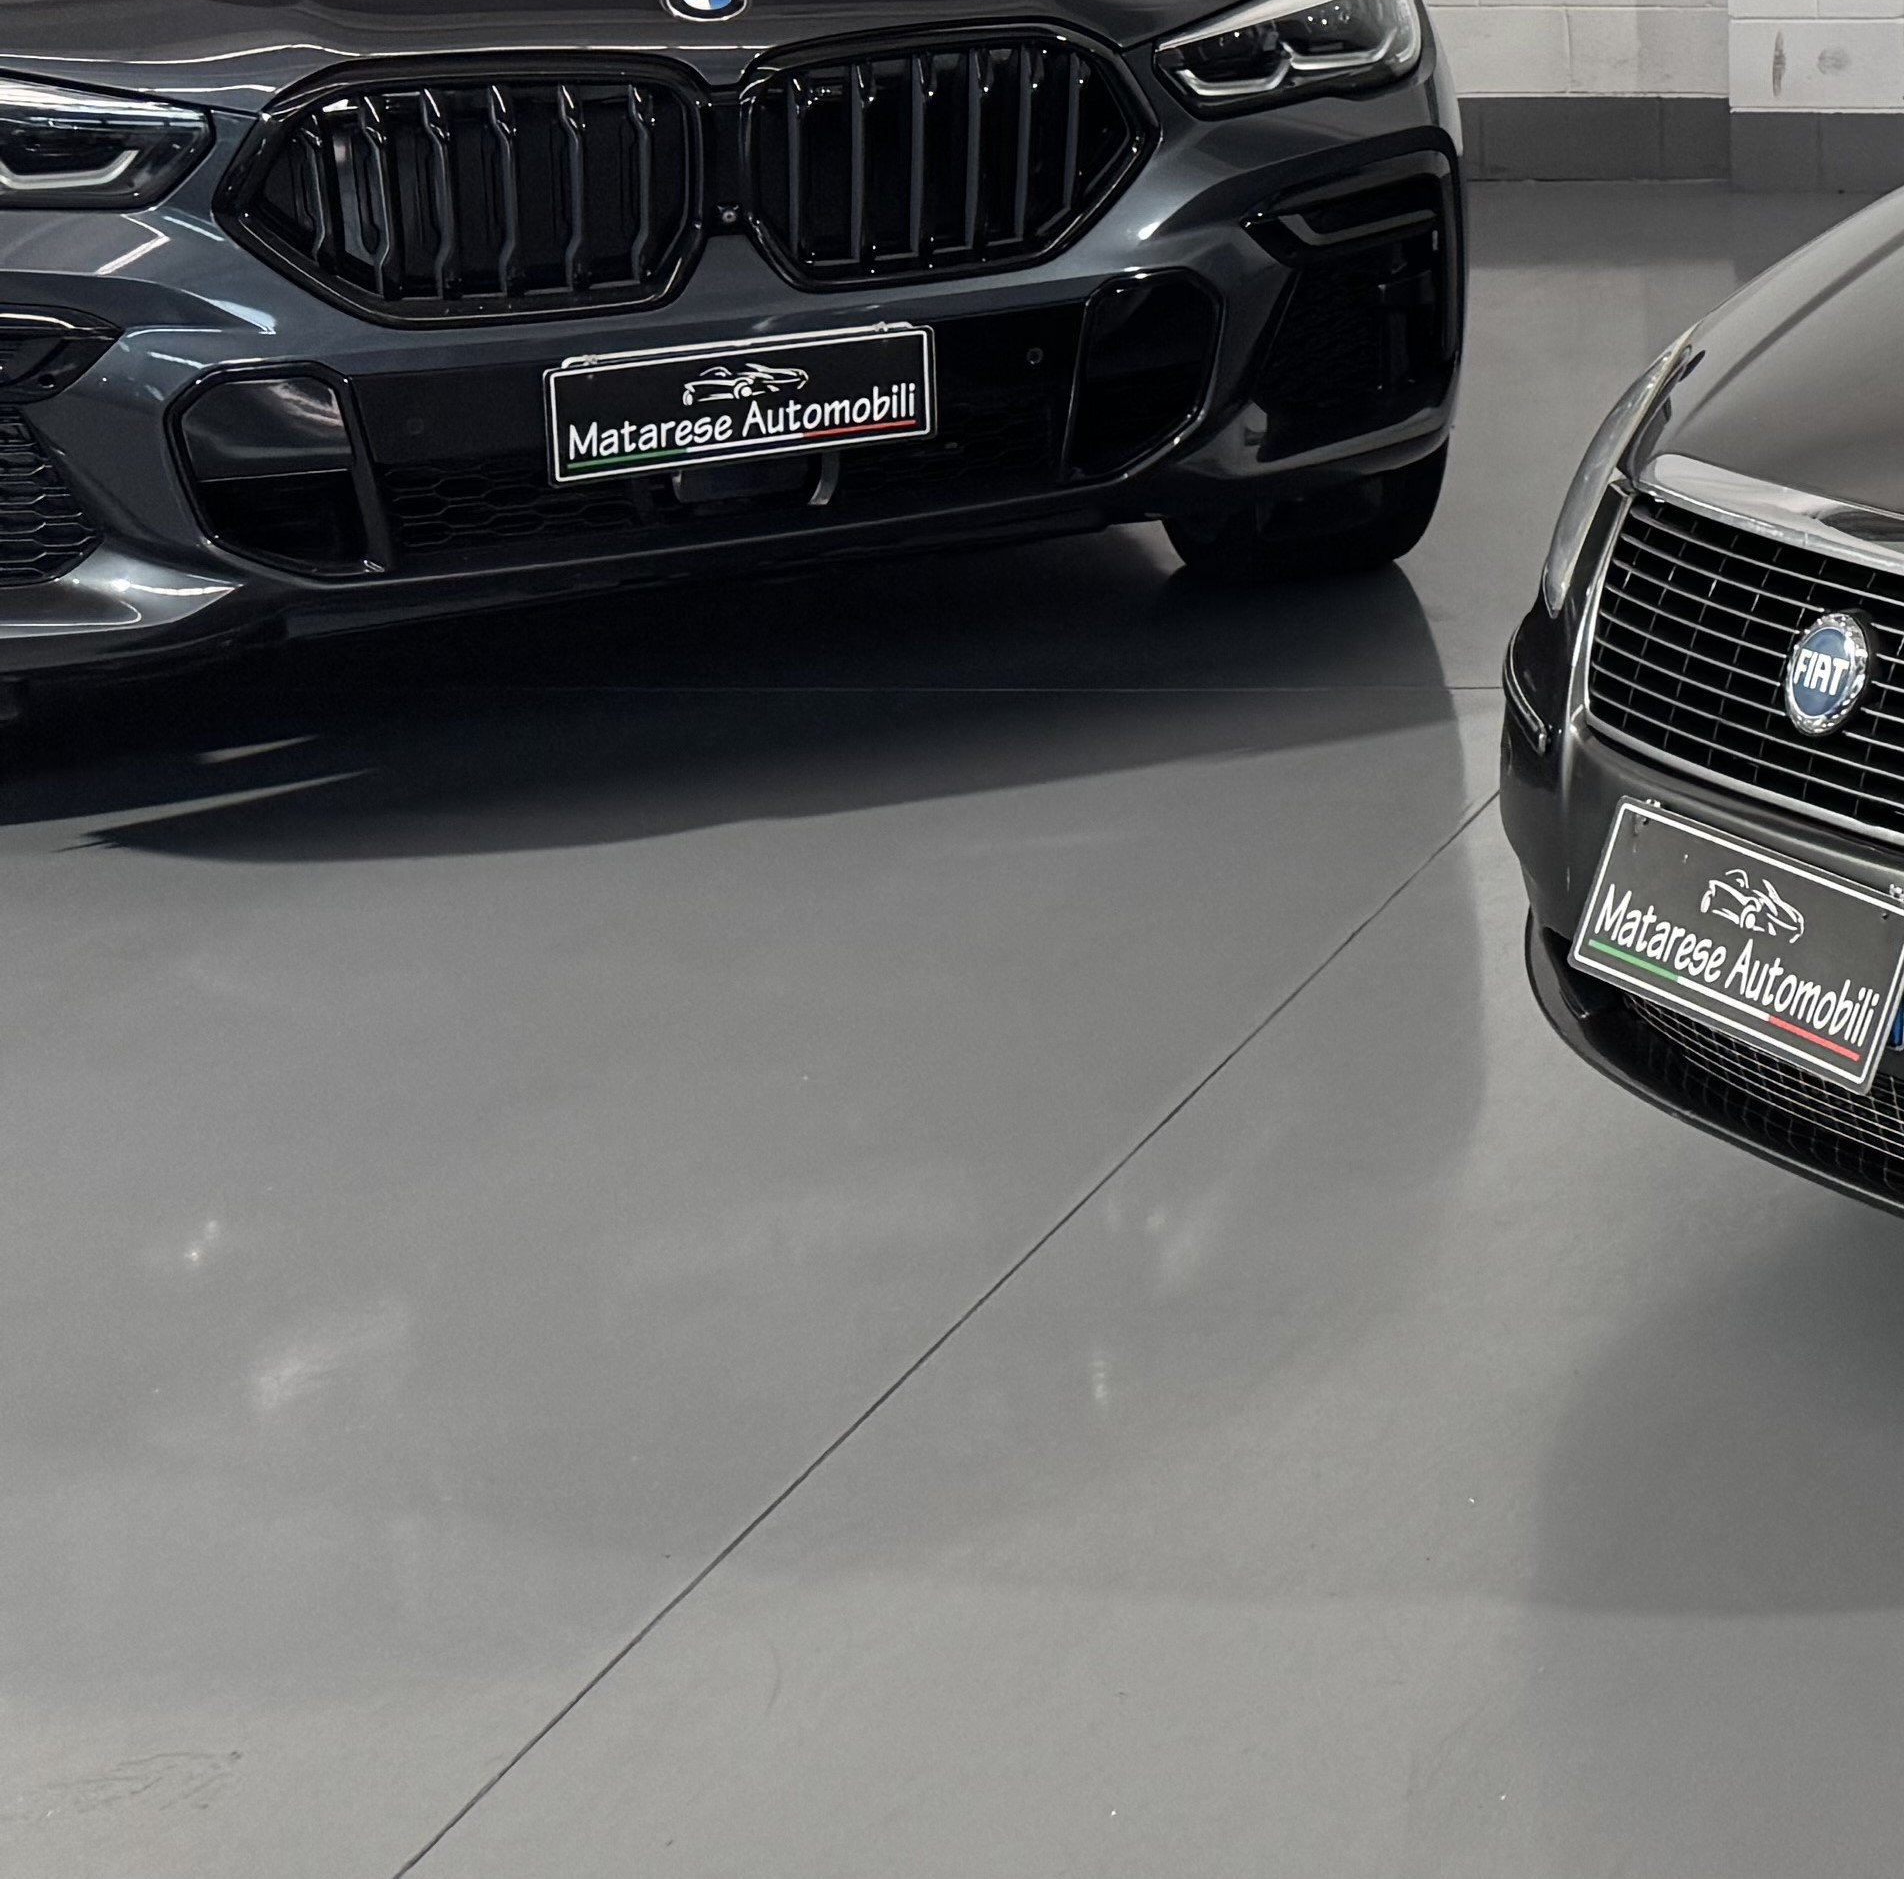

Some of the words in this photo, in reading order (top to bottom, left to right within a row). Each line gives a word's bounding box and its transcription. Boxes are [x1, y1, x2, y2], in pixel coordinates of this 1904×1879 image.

[568, 414, 732, 461] Matarese
[741, 382, 916, 438] Automobili
[1793, 648, 1850, 696] FIAT
[1594, 883, 1725, 984] Matarese
[1725, 939, 1880, 1047] Automobili
